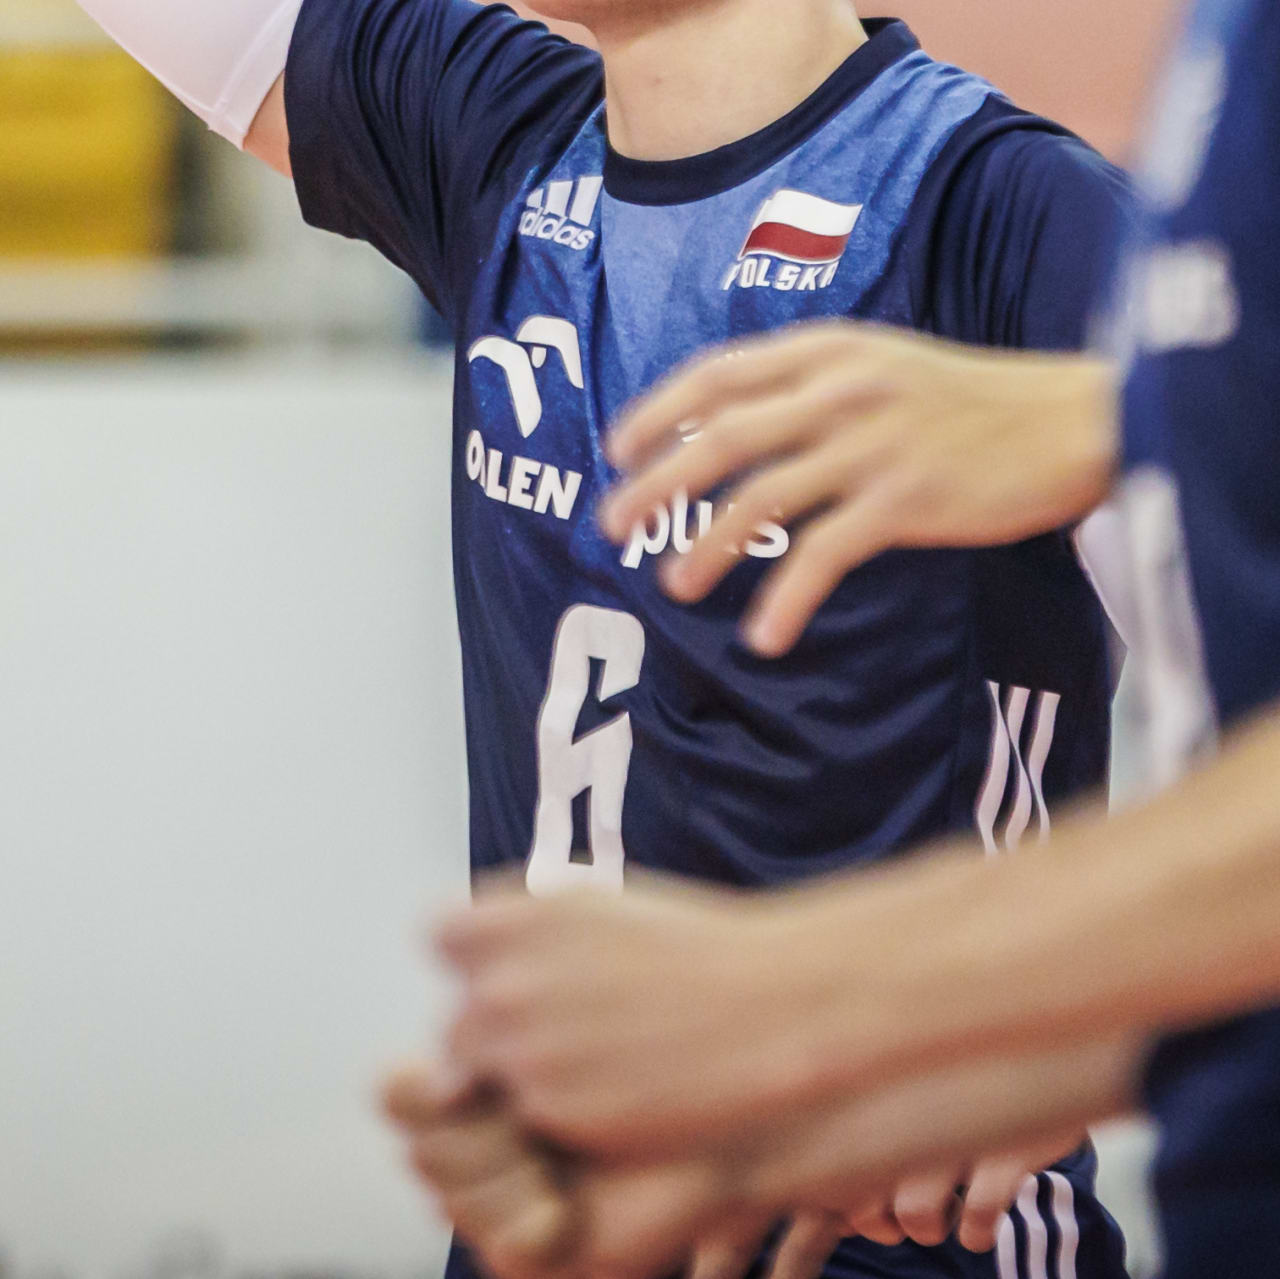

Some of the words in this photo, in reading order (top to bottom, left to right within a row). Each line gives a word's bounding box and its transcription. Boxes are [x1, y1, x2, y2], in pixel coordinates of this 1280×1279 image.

[518, 206, 596, 251] didas
[465, 429, 583, 520] OLEN
[526, 604, 646, 898] 6
